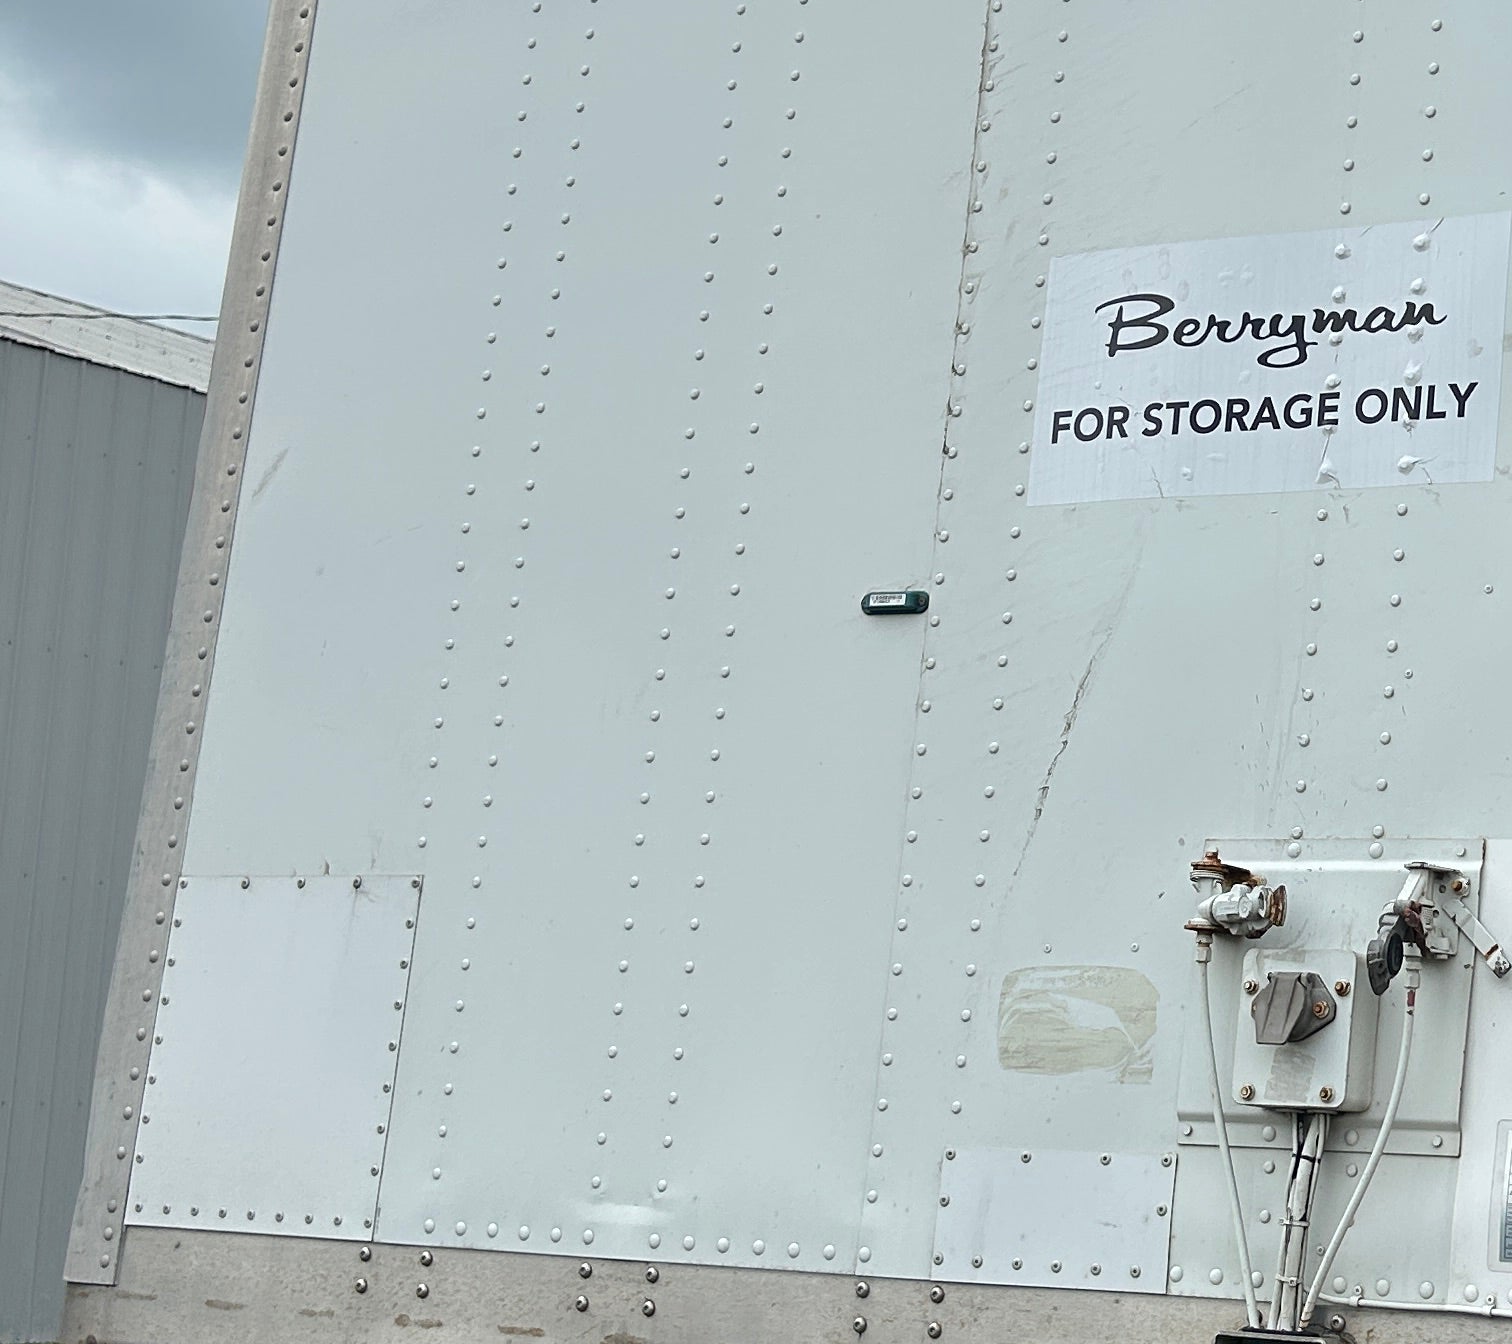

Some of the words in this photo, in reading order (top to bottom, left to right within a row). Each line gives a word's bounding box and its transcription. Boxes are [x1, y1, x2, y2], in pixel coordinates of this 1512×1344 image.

[1095, 294, 1447, 368] Berryman
[1051, 405, 1130, 445] FOR
[1141, 391, 1341, 439] STORAGE
[1355, 381, 1479, 425] ONLY
